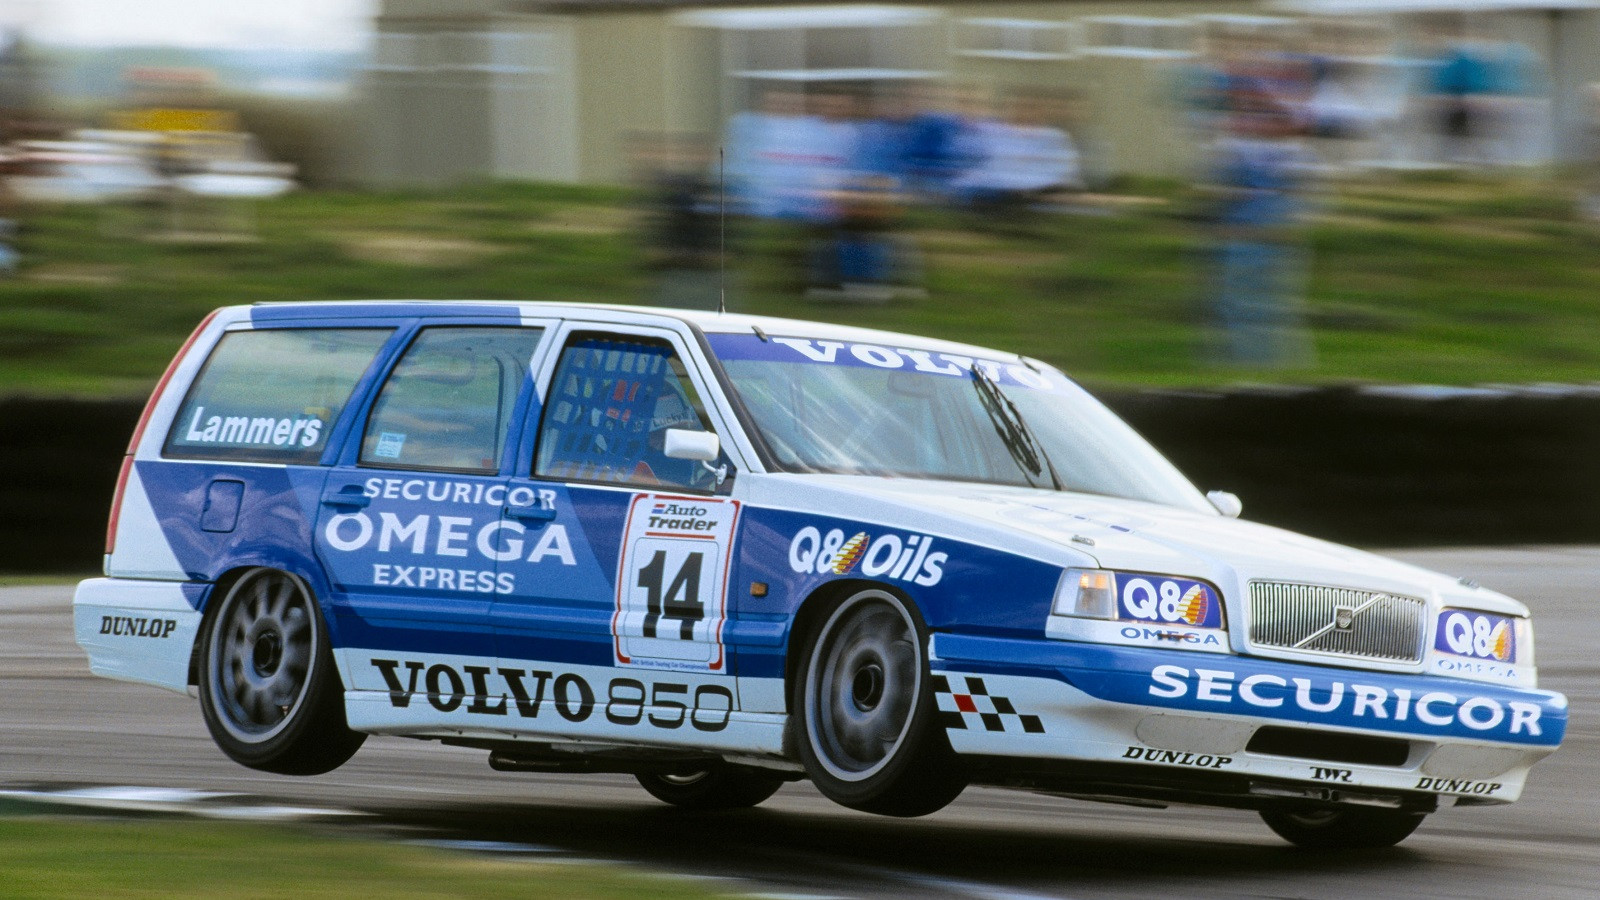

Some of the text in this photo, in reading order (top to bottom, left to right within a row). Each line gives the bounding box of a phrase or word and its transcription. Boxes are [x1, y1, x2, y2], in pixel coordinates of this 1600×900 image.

[772, 338, 1053, 390] VOLVO
[185, 406, 322, 448] Lammers
[364, 477, 557, 511] SECURICOR
[663, 503, 708, 517] Auto
[325, 512, 578, 566] OMEGA
[648, 516, 718, 531] Trader
[789, 525, 949, 587] Q8 Oils
[372, 564, 515, 595] EXPRESS
[637, 550, 705, 641] 14
[1123, 577, 1182, 622] Q8
[99, 615, 177, 639] DUNLOP
[1120, 626, 1220, 646] OMEGA
[1445, 612, 1492, 658] Q8
[370, 658, 733, 733] VOLVO 850
[1149, 664, 1544, 738] SECURICOR
[1122, 746, 1233, 770] DUNLOP
[1309, 766, 1354, 784] TWR
[1415, 776, 1503, 796] DUNLOP
